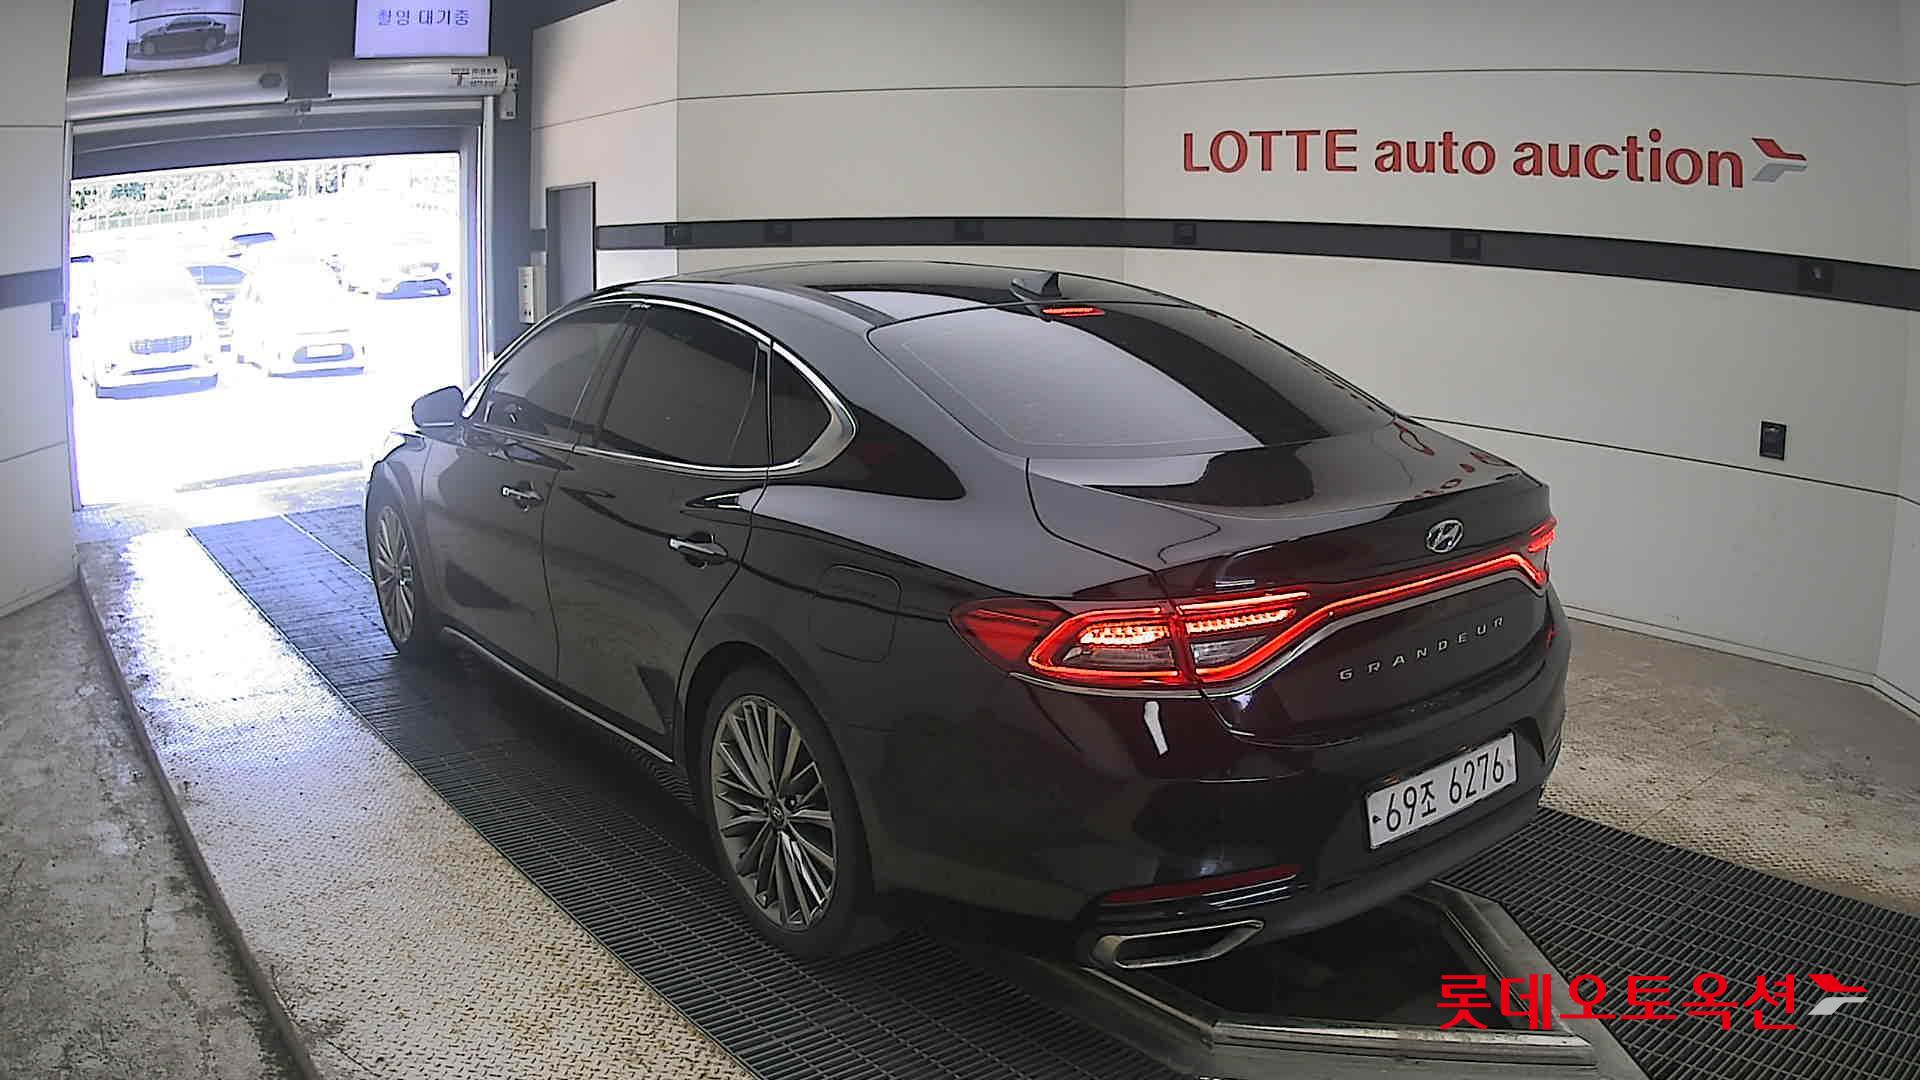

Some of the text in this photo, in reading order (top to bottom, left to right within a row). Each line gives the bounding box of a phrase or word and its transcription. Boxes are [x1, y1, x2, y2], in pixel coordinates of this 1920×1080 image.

[418, 9, 470, 26] 대기중
[1183, 128, 1743, 189] LOTTE auto auction
[1339, 616, 1504, 681] GRANDEUR
[1386, 747, 1504, 832] 69조 6276
